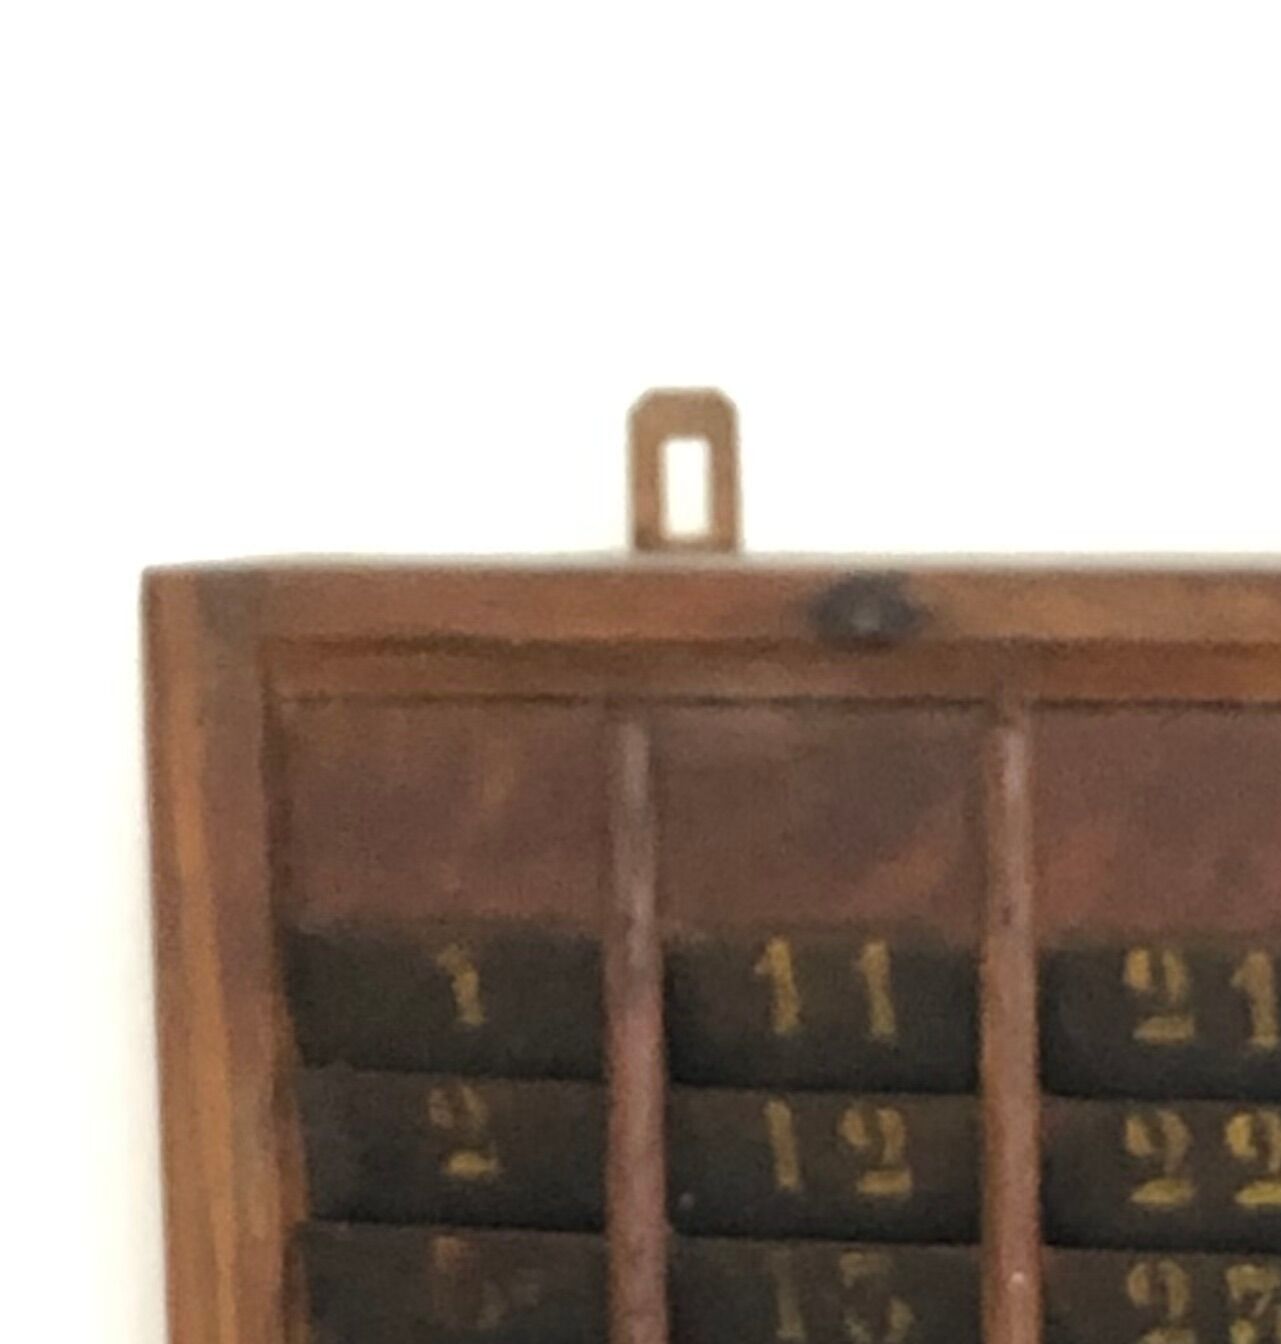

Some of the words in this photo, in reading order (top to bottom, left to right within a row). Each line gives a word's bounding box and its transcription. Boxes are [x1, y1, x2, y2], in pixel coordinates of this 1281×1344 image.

[436, 943, 486, 1027] 1
[754, 937, 898, 1037] 11
[1123, 947, 1281, 1050] 21
[427, 1085, 502, 1181] 2
[764, 1099, 914, 1198] 12
